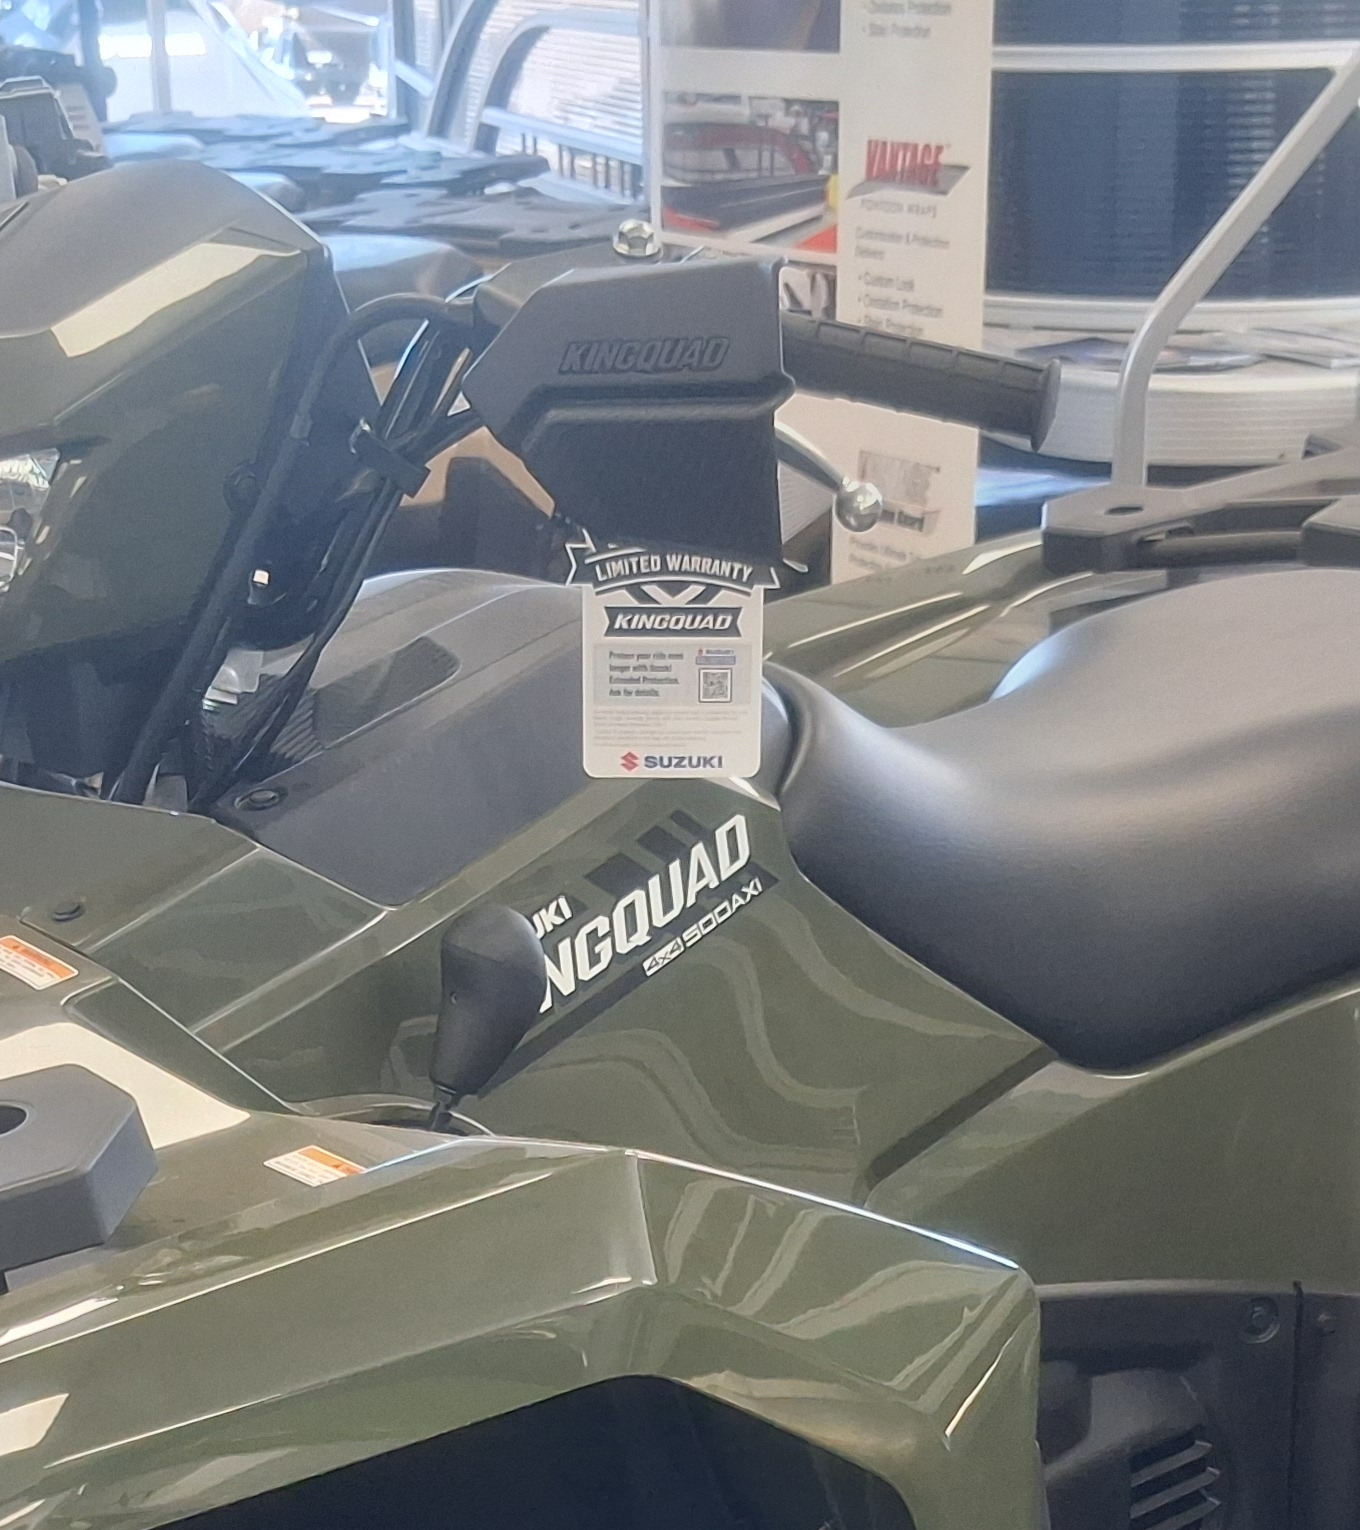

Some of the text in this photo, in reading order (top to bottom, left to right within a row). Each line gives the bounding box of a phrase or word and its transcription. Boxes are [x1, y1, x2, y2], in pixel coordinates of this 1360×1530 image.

[866, 139, 945, 187] VANTAGE
[558, 336, 731, 375] KINGQUAD
[595, 553, 754, 583] LIMITED WARRANTY
[613, 613, 733, 631] KINGQUAD
[644, 755, 723, 769] SUZUKI
[644, 937, 685, 976] 4x4
